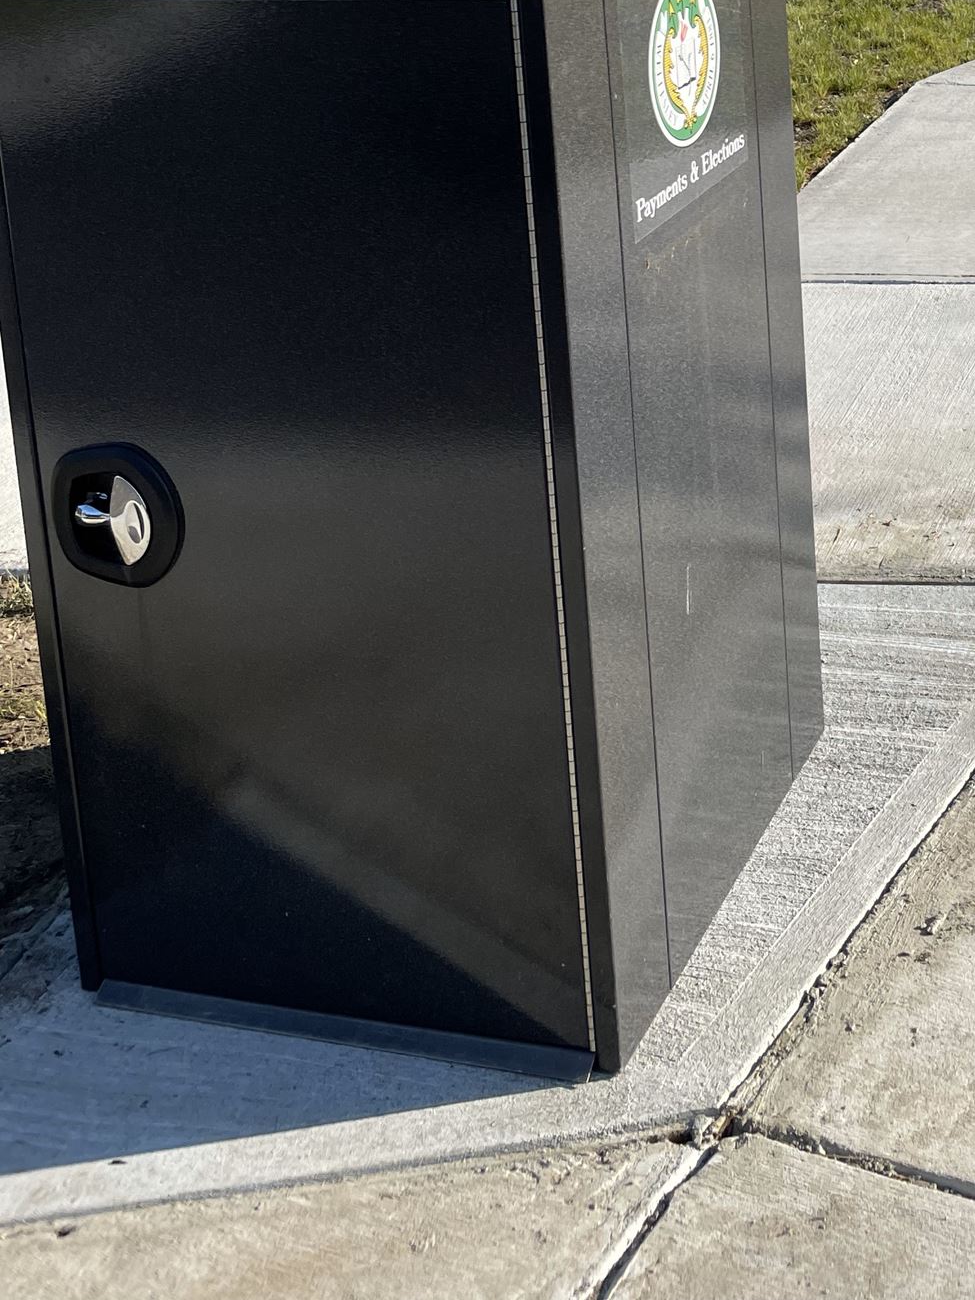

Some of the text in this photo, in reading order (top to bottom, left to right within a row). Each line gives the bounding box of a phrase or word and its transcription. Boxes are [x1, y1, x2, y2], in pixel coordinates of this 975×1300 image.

[635, 134, 745, 223] Payments & Elections
